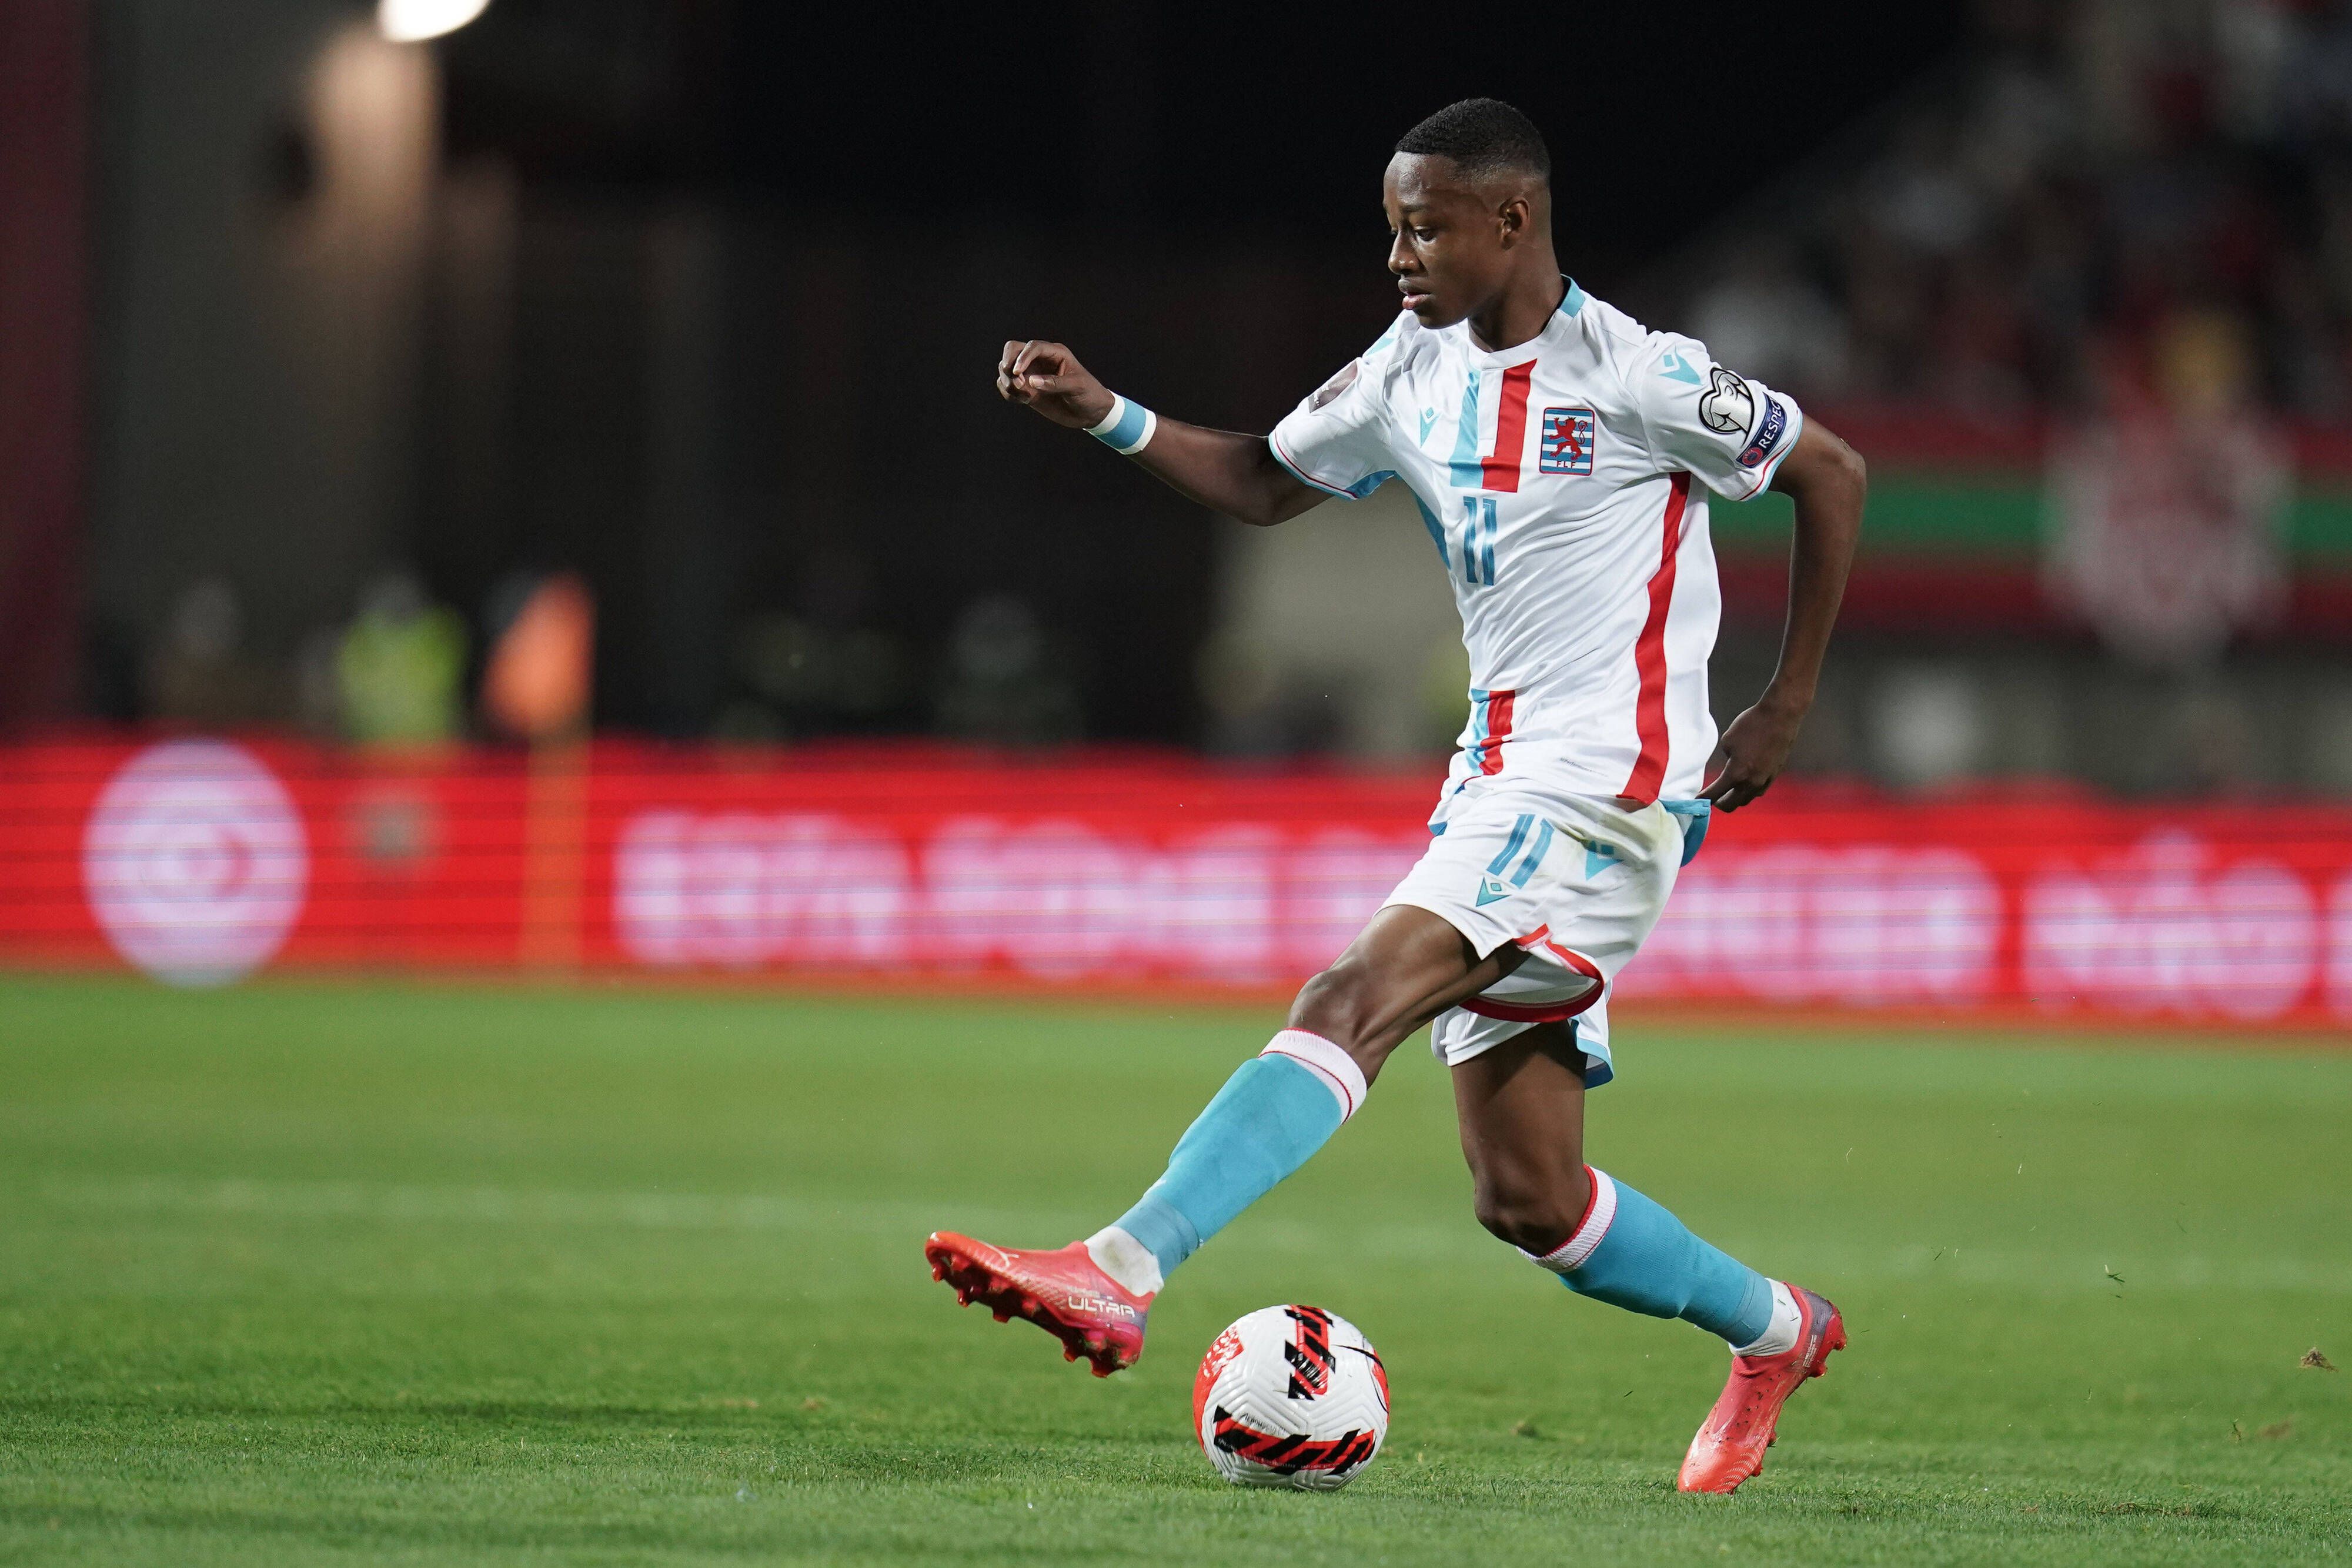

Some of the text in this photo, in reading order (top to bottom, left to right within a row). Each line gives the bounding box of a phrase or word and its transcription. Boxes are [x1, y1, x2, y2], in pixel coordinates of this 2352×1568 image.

[1758, 398, 1782, 449] RESPEC
[1556, 460, 1576, 469] FLF
[1463, 496, 1497, 586] 11
[1486, 813, 1555, 890] 11
[1068, 1295, 1135, 1318] ULTRA
